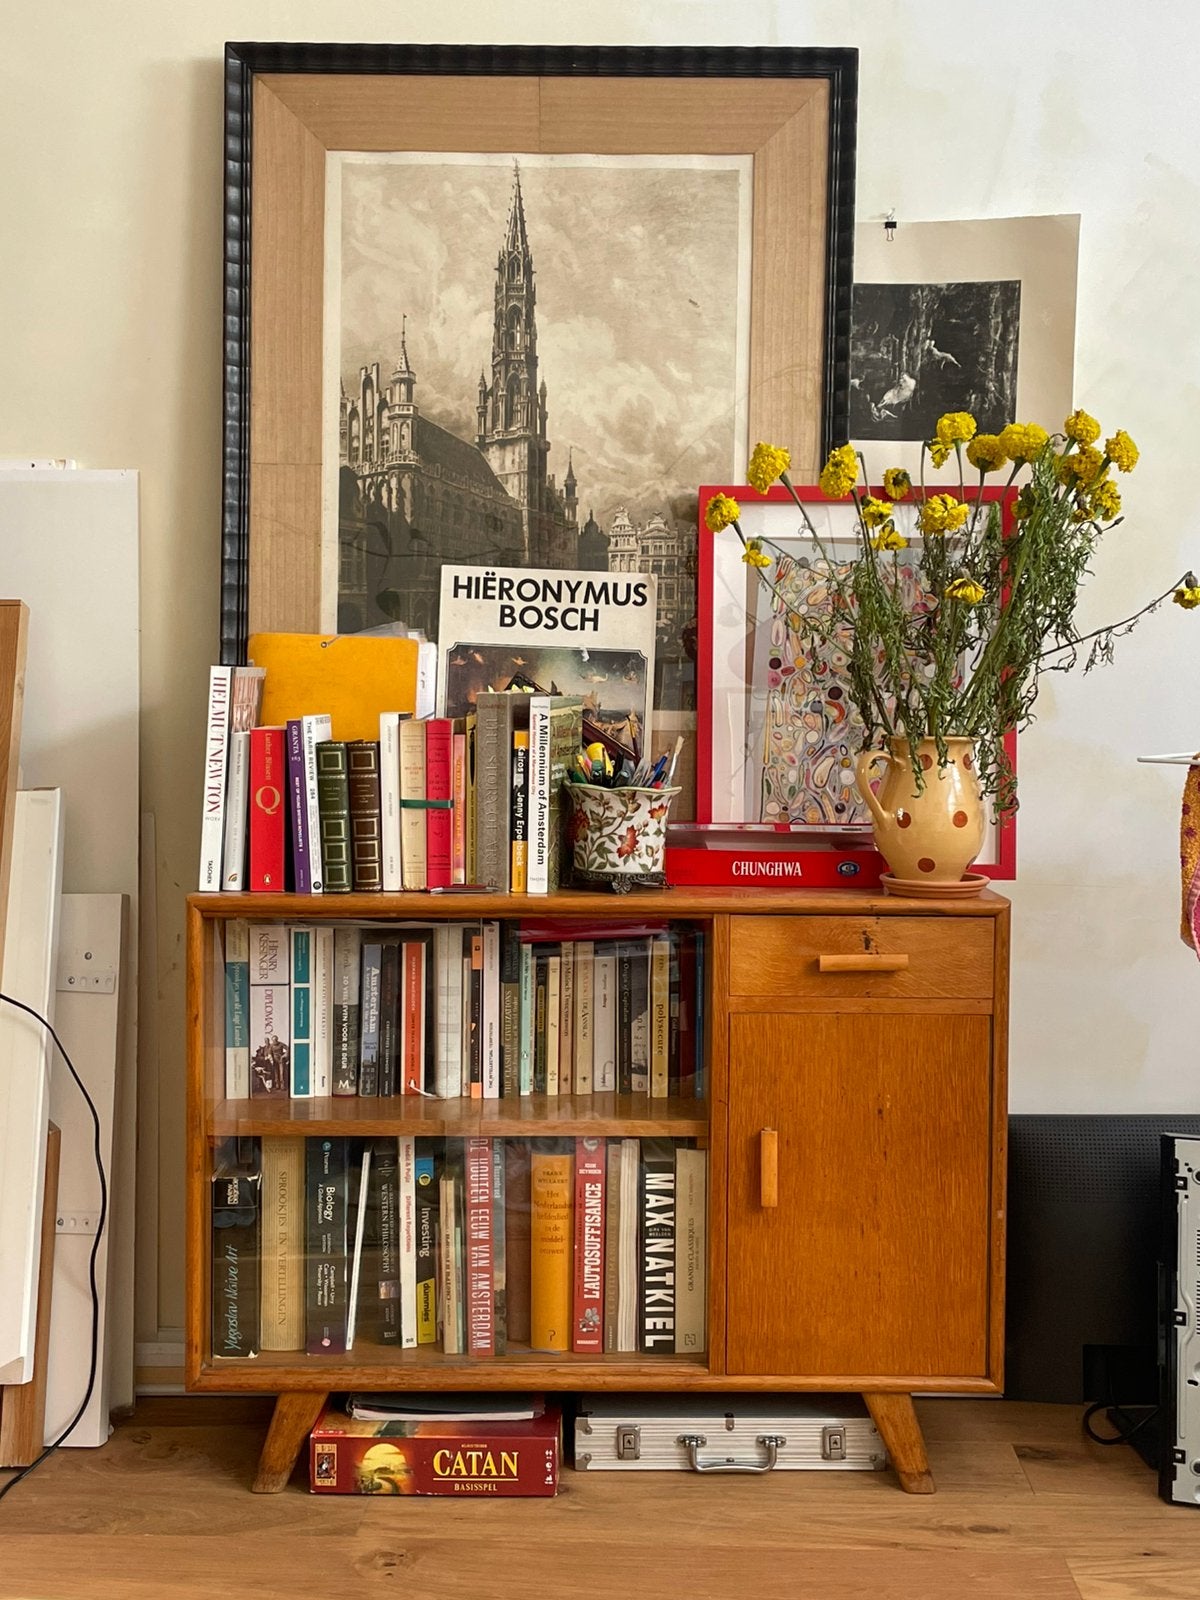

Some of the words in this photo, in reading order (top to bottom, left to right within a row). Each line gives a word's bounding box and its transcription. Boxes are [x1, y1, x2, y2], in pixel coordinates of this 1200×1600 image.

[453, 571, 649, 606] HIËRONYMUS
[499, 605, 600, 632] BOSCH
[209, 677, 227, 745] HELMUT
[539, 713, 548, 722] A
[264, 733, 273, 754] Luther
[291, 726, 302, 755] GRANTA
[485, 717, 498, 745] THE
[264, 757, 273, 780] Blissett
[517, 746, 526, 772] Kairos
[538, 725, 548, 787] Millennium
[206, 749, 225, 814] NEWTON
[485, 755, 498, 806] STORY
[538, 789, 547, 801] of
[255, 786, 281, 815] Q
[516, 792, 525, 817] Jenny
[486, 811, 498, 829] OF
[537, 802, 547, 866] Amsterdam
[486, 838, 498, 868] ART
[516, 820, 525, 866] Erpenbeck
[732, 861, 803, 877] CHUNGHWA
[259, 932, 268, 980] KISSINGER
[269, 940, 278, 972] HENRY
[342, 975, 349, 985] ZO
[622, 963, 630, 983] Origin
[264, 989, 274, 1036] DIPLOMACY
[369, 967, 380, 1033] Amsterdam
[622, 992, 630, 1023] Capitalism
[504, 990, 512, 1041] CIVILIZATIONS
[656, 1004, 667, 1056] polysecure
[504, 1044, 512, 1053] OF
[504, 1054, 512, 1078] CLASH
[504, 1080, 512, 1094] THE
[470, 1138, 489, 1152] DE
[470, 1158, 489, 1203] HOUTEN
[278, 1171, 288, 1226] SPROOKJES
[324, 1187, 336, 1221] Biology
[608, 1200, 617, 1211] LA
[645, 1173, 675, 1227] MAX
[419, 1207, 431, 1257] Investing
[470, 1209, 490, 1239] EEUW
[608, 1214, 617, 1225] DE
[279, 1231, 288, 1245] EN
[583, 1183, 602, 1299] L'AUTOSUFFISANCE
[608, 1231, 616, 1271] MANUEL
[687, 1218, 695, 1261] CLASSIQUES
[224, 1244, 238, 1265] Art
[471, 1245, 490, 1267] VAN
[224, 1267, 238, 1300] Naive
[278, 1251, 288, 1326] VERTELLINGEN
[608, 1274, 616, 1301] PETIT
[645, 1238, 675, 1348] NATKIEL
[422, 1283, 431, 1322] dummies
[470, 1272, 491, 1349] AMSTERDAM
[608, 1305, 616, 1315] LE
[224, 1303, 242, 1350] Yugoslav
[432, 1449, 520, 1477] CATAN
[453, 1483, 499, 1492] BASISSPEL
